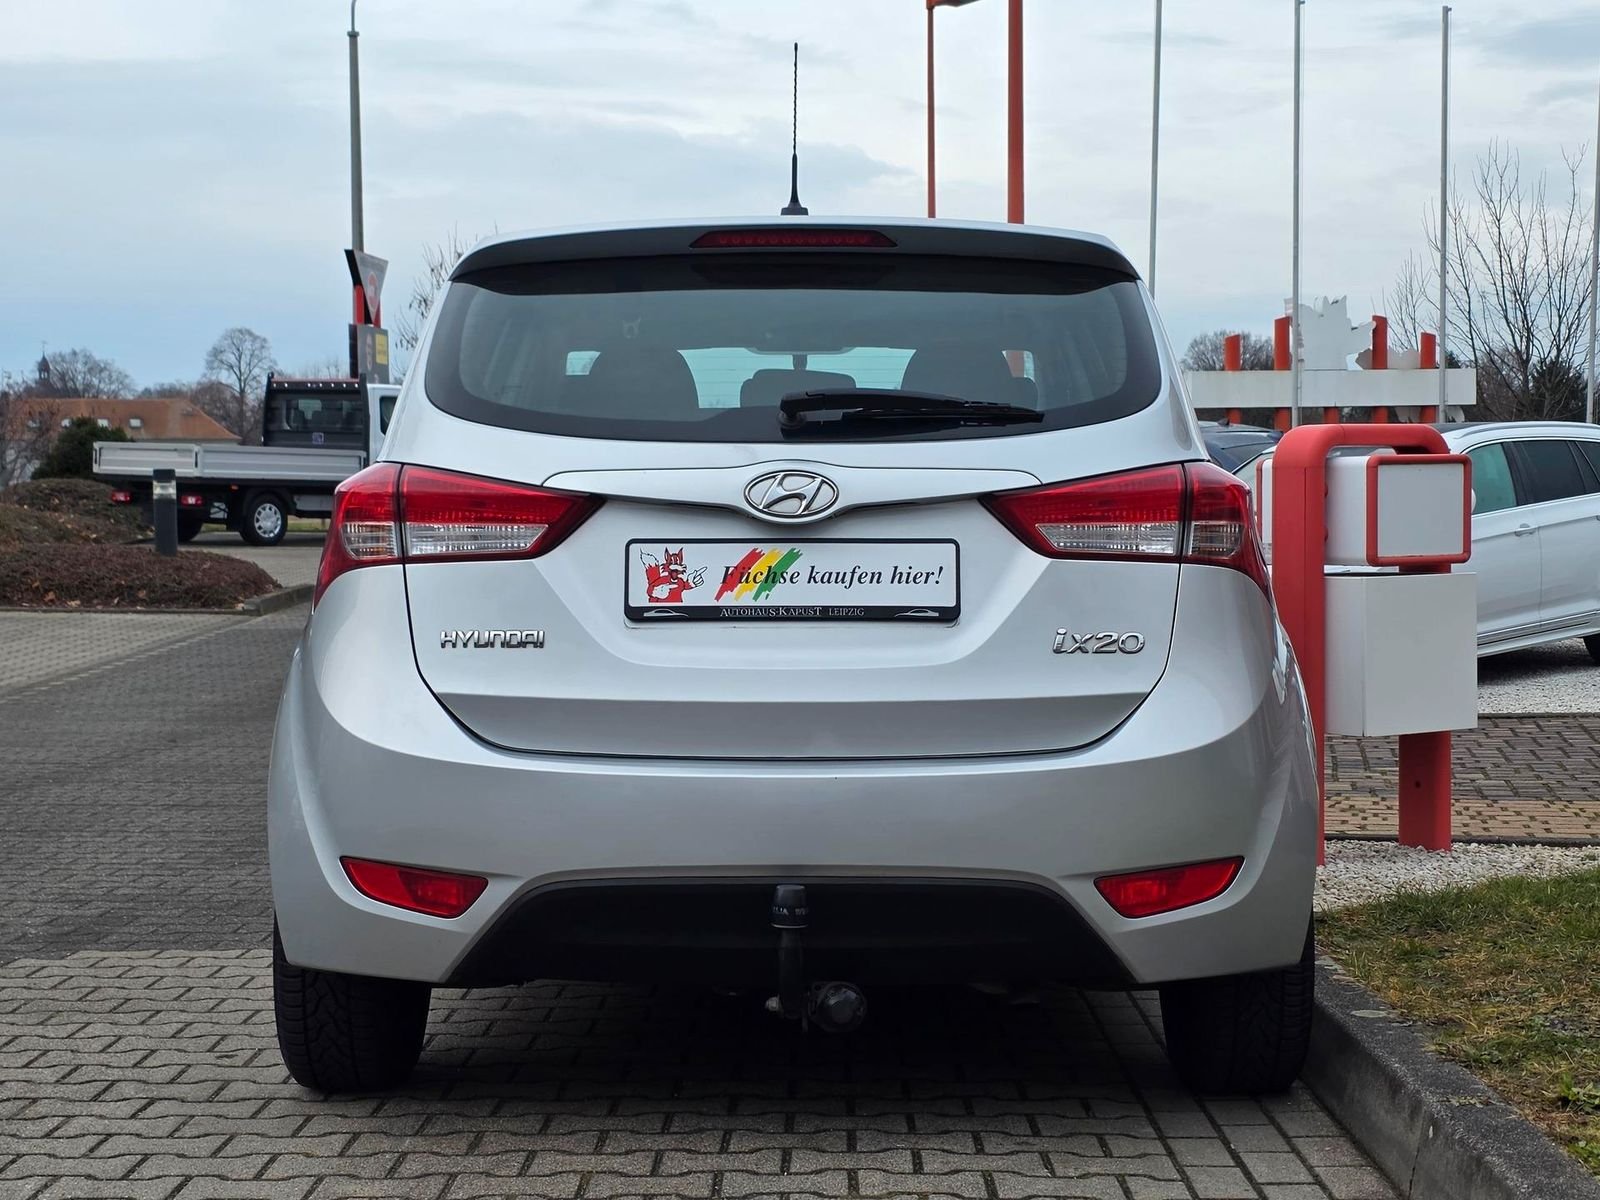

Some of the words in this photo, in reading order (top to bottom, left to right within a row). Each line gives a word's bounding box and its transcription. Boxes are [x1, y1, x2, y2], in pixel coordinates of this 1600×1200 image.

[720, 565, 801, 585] Füchse
[806, 565, 883, 590] kaufen
[889, 565, 944, 585] hier!
[828, 607, 865, 617] LEIPZIG
[440, 629, 546, 649] HYUNDAI
[1052, 627, 1146, 654] ix20
